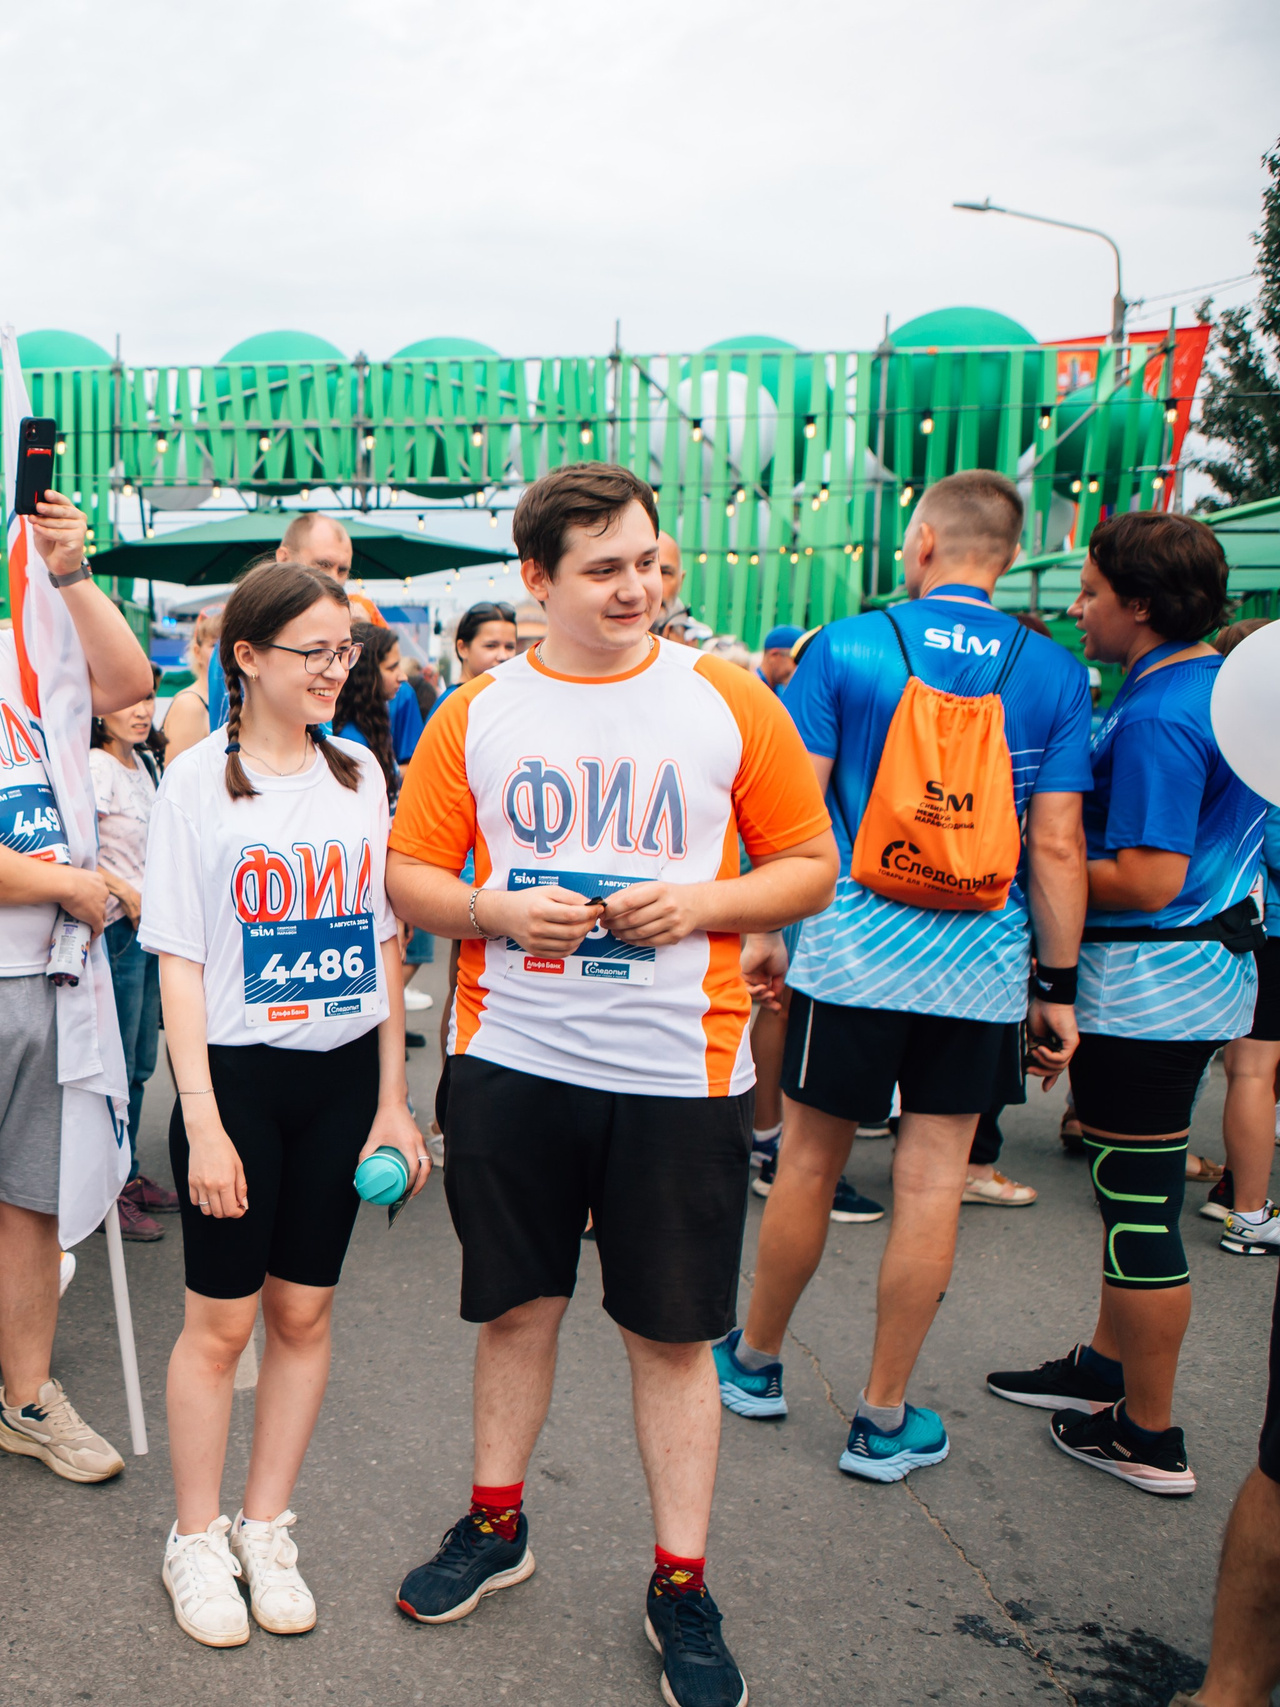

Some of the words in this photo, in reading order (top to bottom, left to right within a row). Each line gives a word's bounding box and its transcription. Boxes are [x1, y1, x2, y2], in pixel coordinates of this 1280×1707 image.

[501, 755, 688, 860] ФИЛ
[13, 806, 61, 837] 449
[894, 854, 998, 891] Следопыт
[260, 945, 365, 985] 4486
[526, 960, 545, 969] Альфа
[545, 961, 561, 969] Банк
[589, 966, 627, 976] Следопыт
[271, 1009, 291, 1019] Альфа
[291, 1008, 306, 1016] Банк
[330, 1004, 360, 1014] Следопыт
[1111, 1440, 1132, 1458] PUMA
